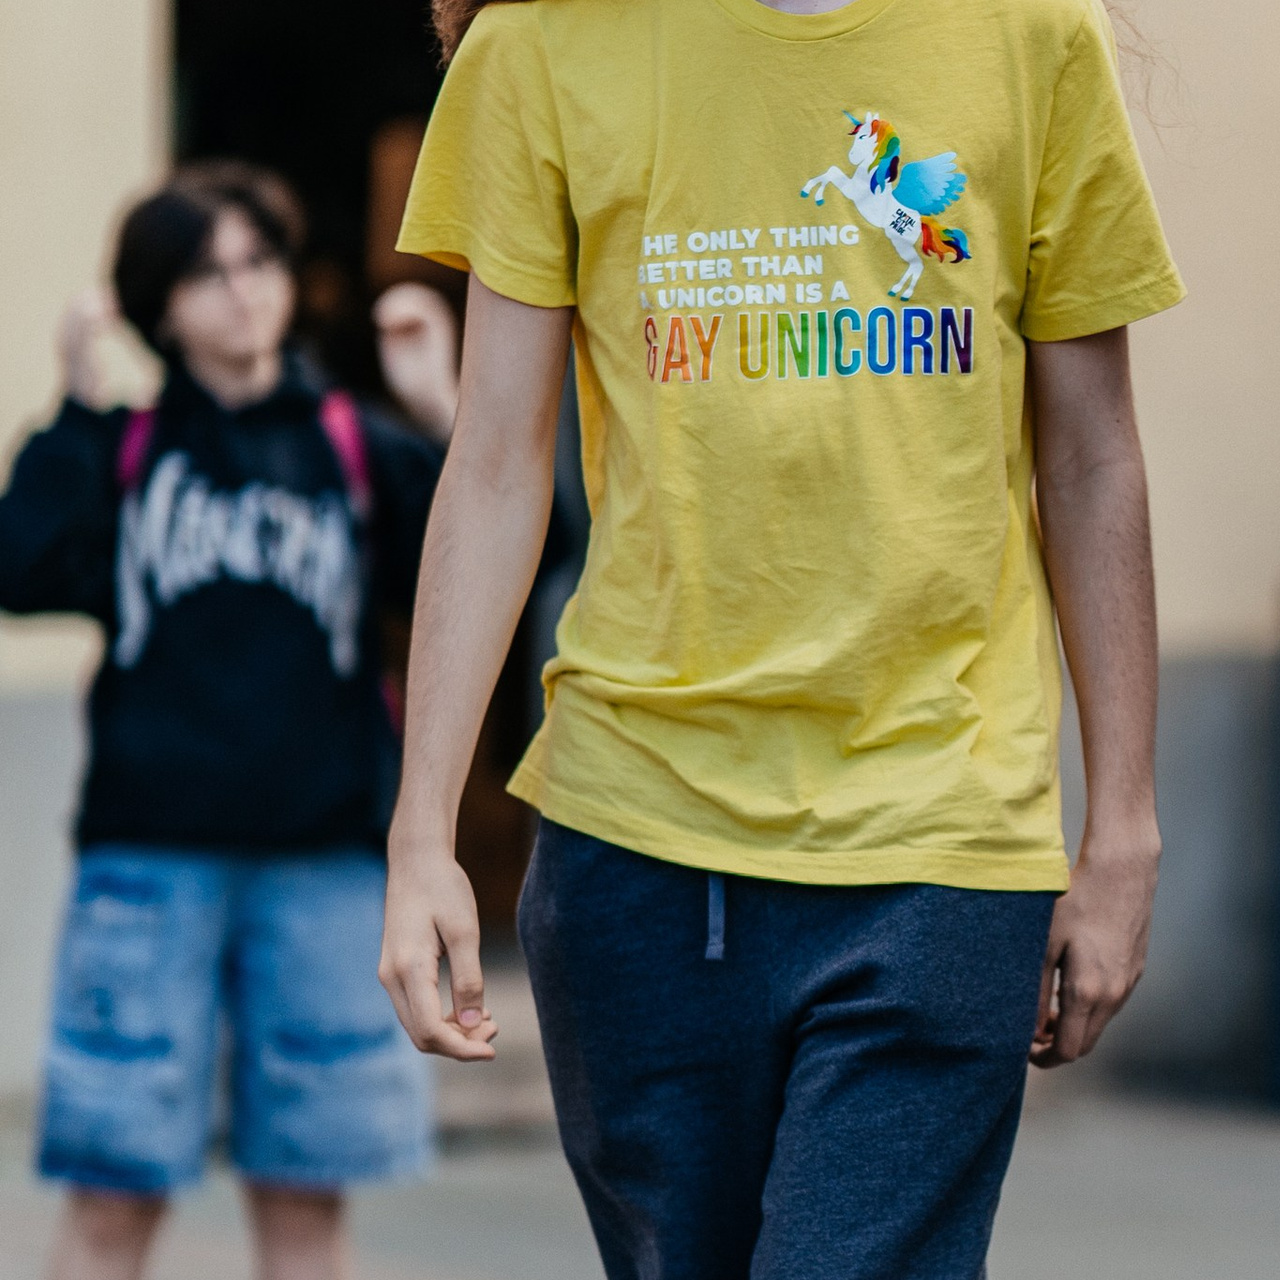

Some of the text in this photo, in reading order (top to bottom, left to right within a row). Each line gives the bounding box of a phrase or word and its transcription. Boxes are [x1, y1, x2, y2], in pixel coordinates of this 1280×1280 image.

[644, 225, 859, 256] HE ONLY THING
[742, 255, 823, 277] THAN
[657, 284, 786, 310] UNICORN
[796, 282, 822, 303] IS
[831, 281, 850, 301] A
[643, 306, 975, 383] GAY UNICORN
